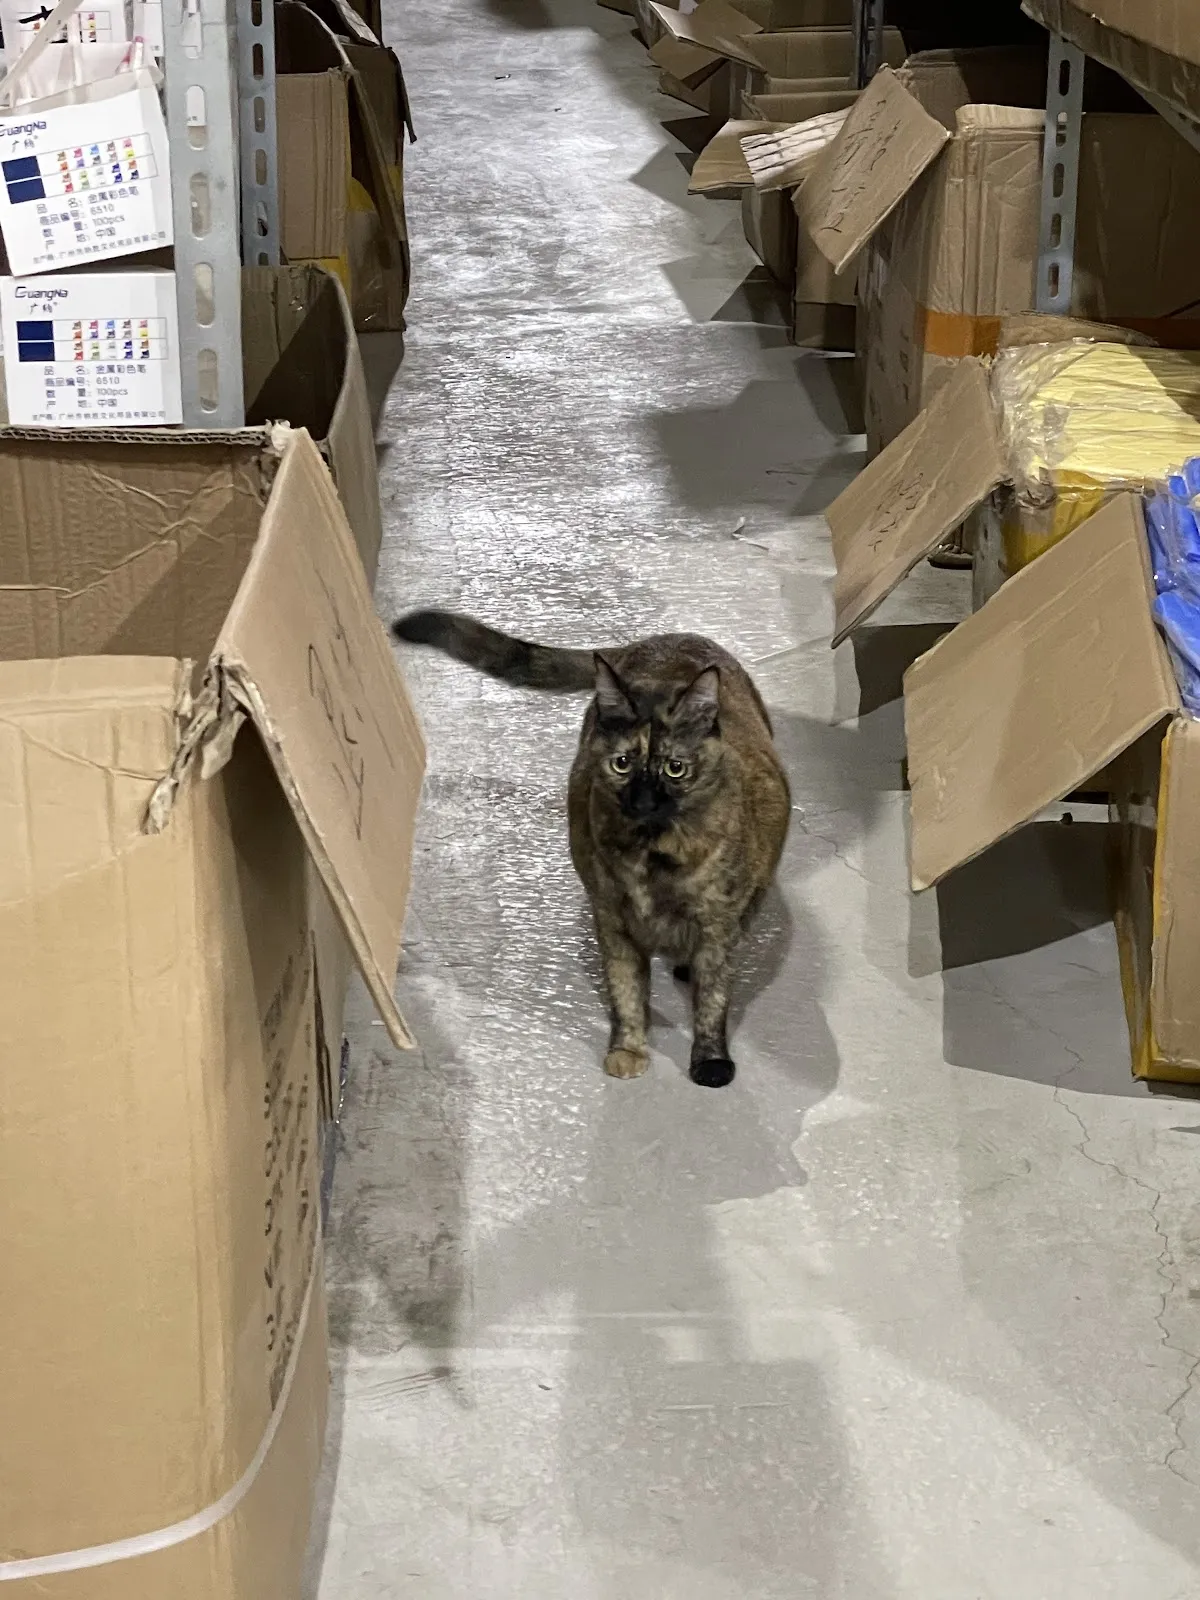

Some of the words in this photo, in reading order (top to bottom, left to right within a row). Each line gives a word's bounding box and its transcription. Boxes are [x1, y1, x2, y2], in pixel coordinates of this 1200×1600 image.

[0, 121, 47, 136] GuangNa
[92, 214, 126, 227] 100pcs
[15, 286, 69, 301] GuangNa
[96, 376, 120, 385] 6510
[96, 388, 128, 397] 100pcs
